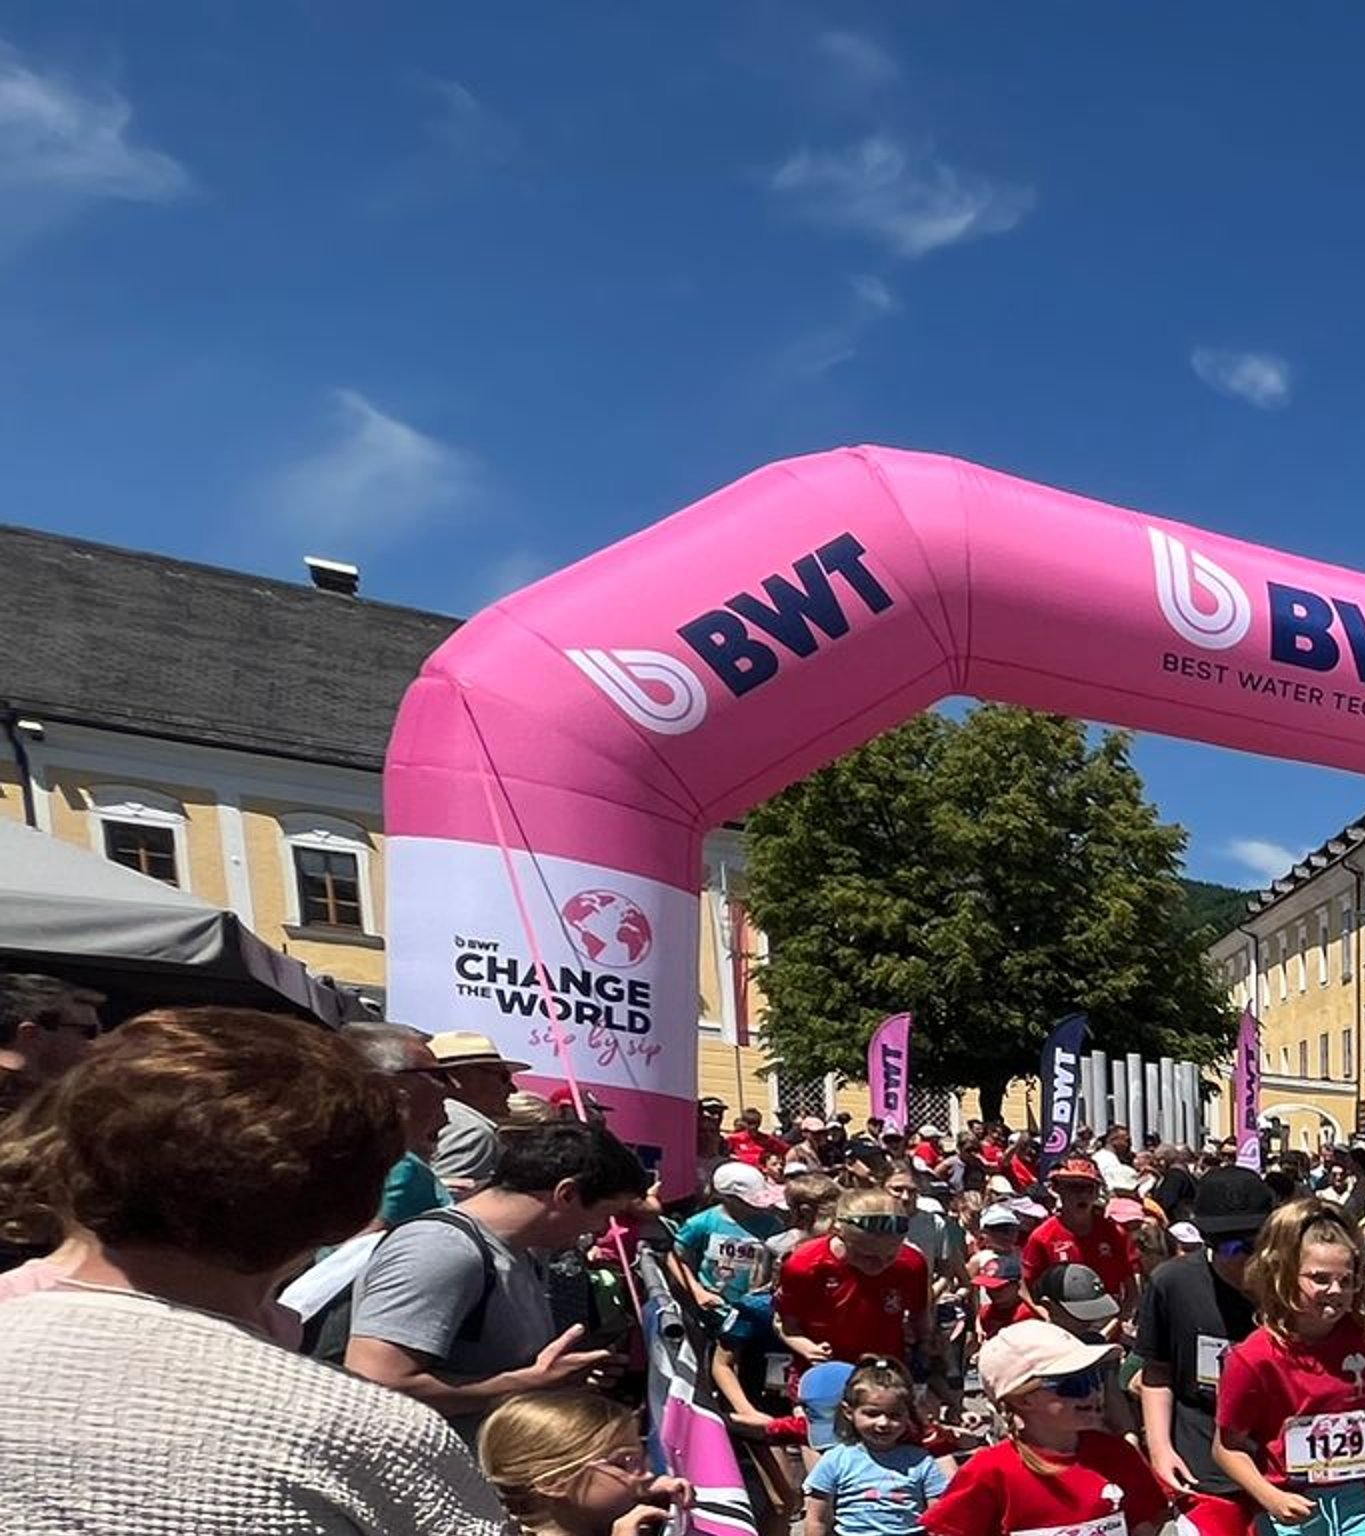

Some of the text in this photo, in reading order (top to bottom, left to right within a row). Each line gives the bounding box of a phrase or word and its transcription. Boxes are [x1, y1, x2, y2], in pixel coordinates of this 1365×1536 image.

[677, 531, 895, 698] BWT
[1163, 652, 1229, 684] BEST
[1237, 671, 1326, 705] WATER
[455, 954, 651, 1009] CHANGE
[456, 983, 651, 1034] THE WORLD
[1052, 1047, 1076, 1123] BWT
[1305, 1431, 1365, 1459] 1129
